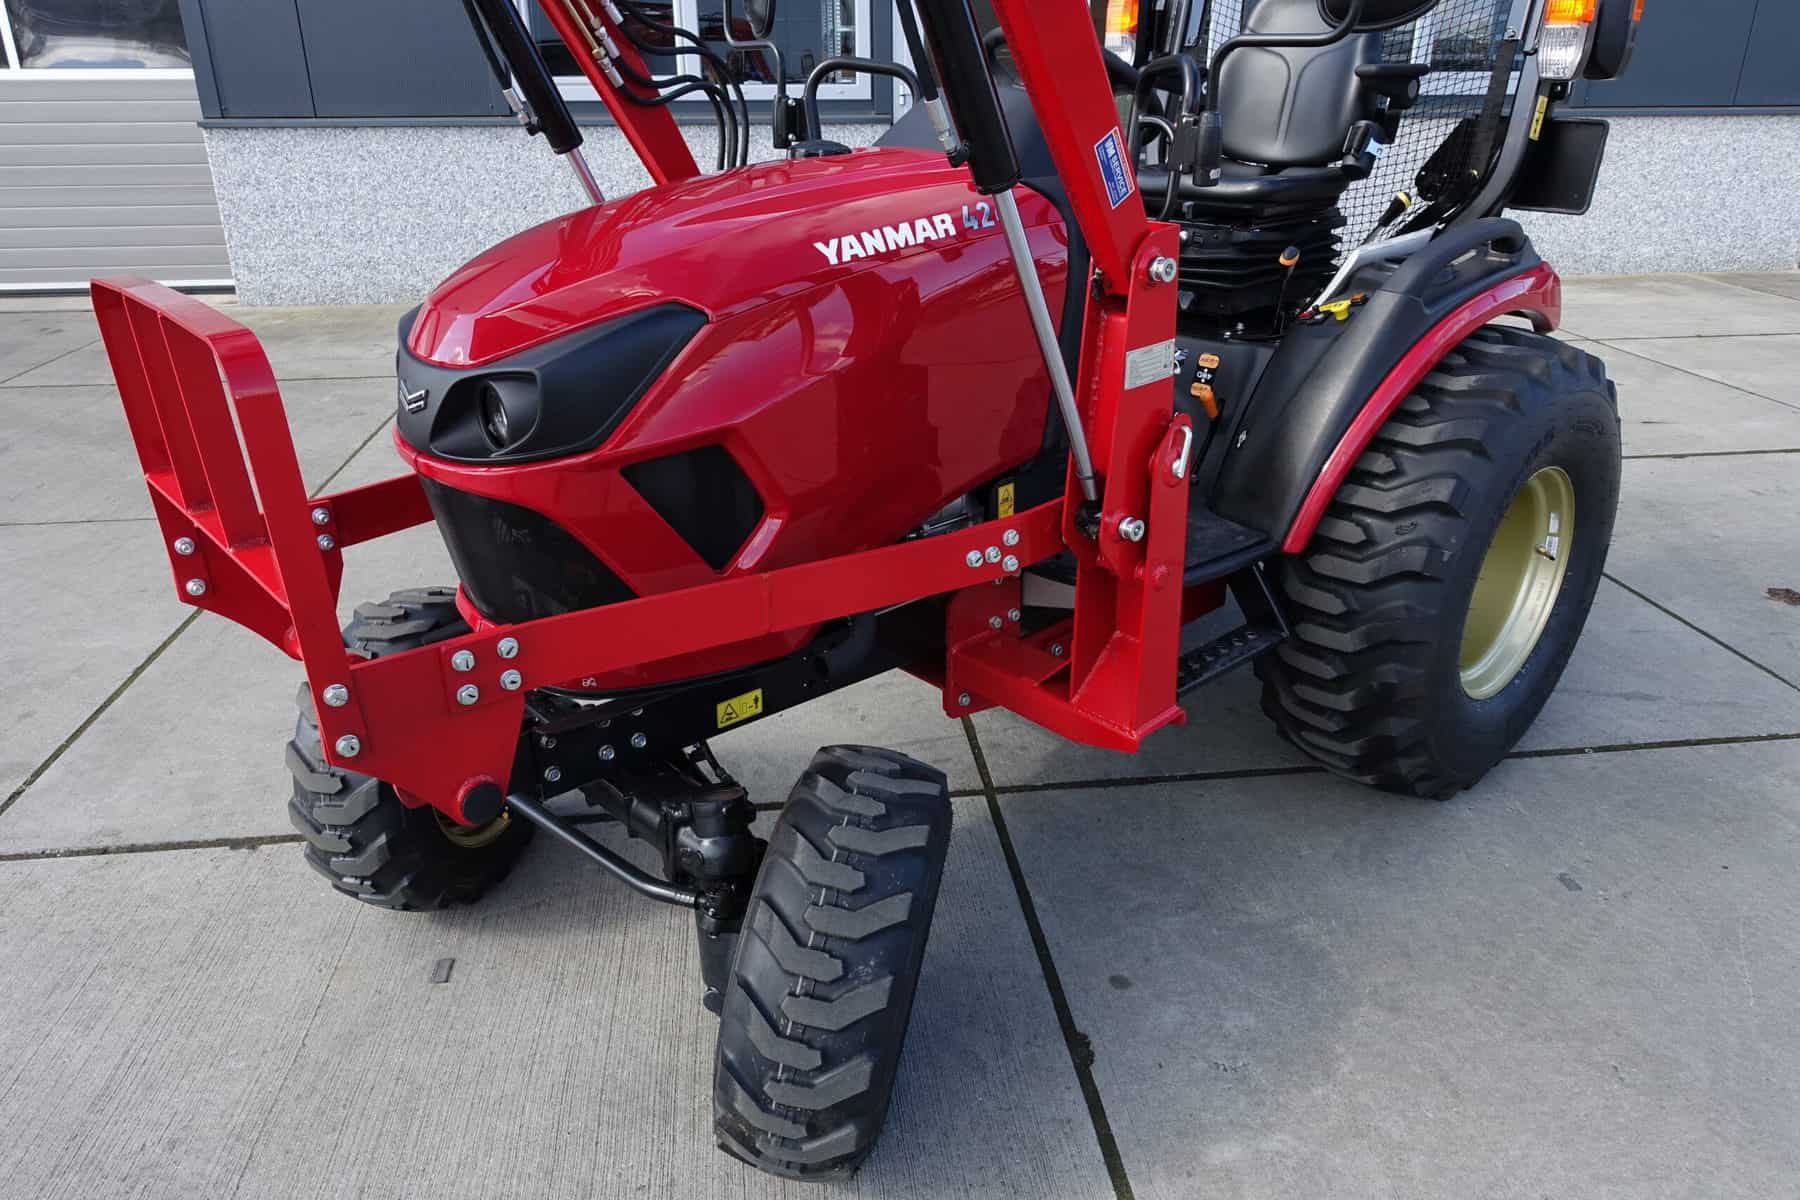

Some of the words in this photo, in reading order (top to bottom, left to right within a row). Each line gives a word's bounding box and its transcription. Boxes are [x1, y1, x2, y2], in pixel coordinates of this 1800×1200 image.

[1111, 153, 1127, 195] SERVICE
[813, 213, 956, 265] YANMAR
[962, 202, 1000, 230] 42
